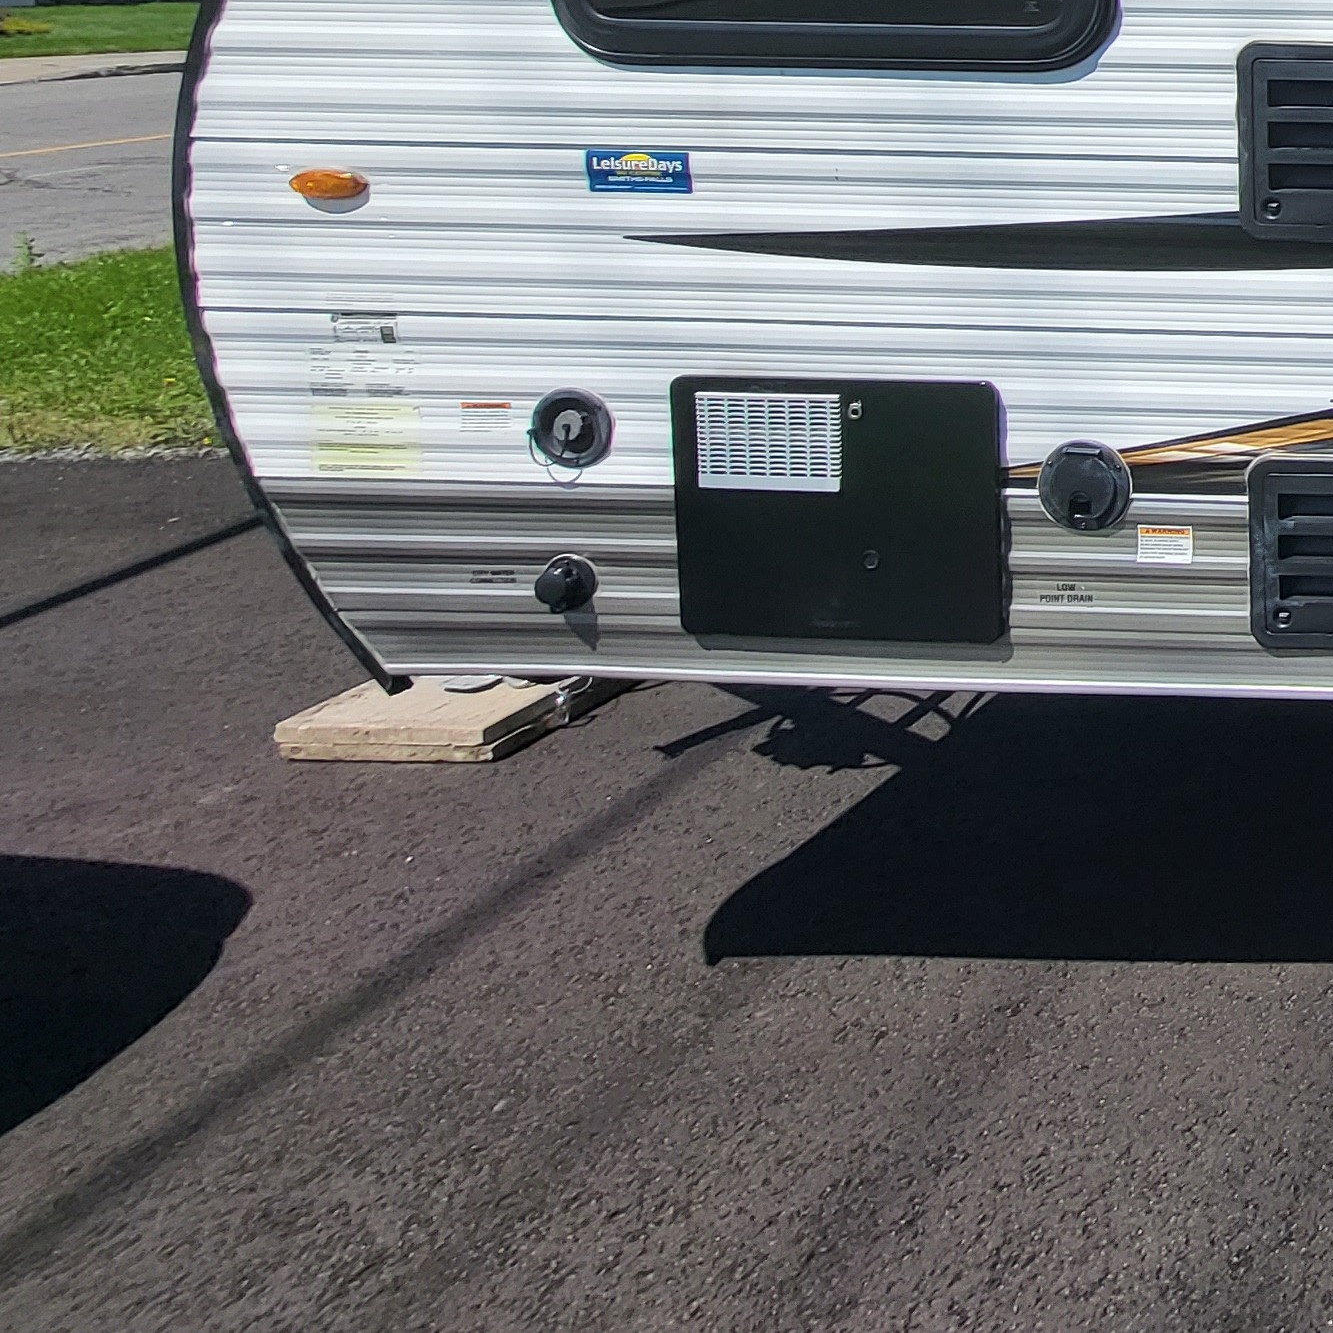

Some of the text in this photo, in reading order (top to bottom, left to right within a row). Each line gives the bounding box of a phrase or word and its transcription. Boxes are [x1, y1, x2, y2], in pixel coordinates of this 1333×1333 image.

[592, 156, 682, 173] LeisureDays
[1056, 583, 1076, 591] LOW
[1040, 594, 1093, 603] POINT DRAIN
